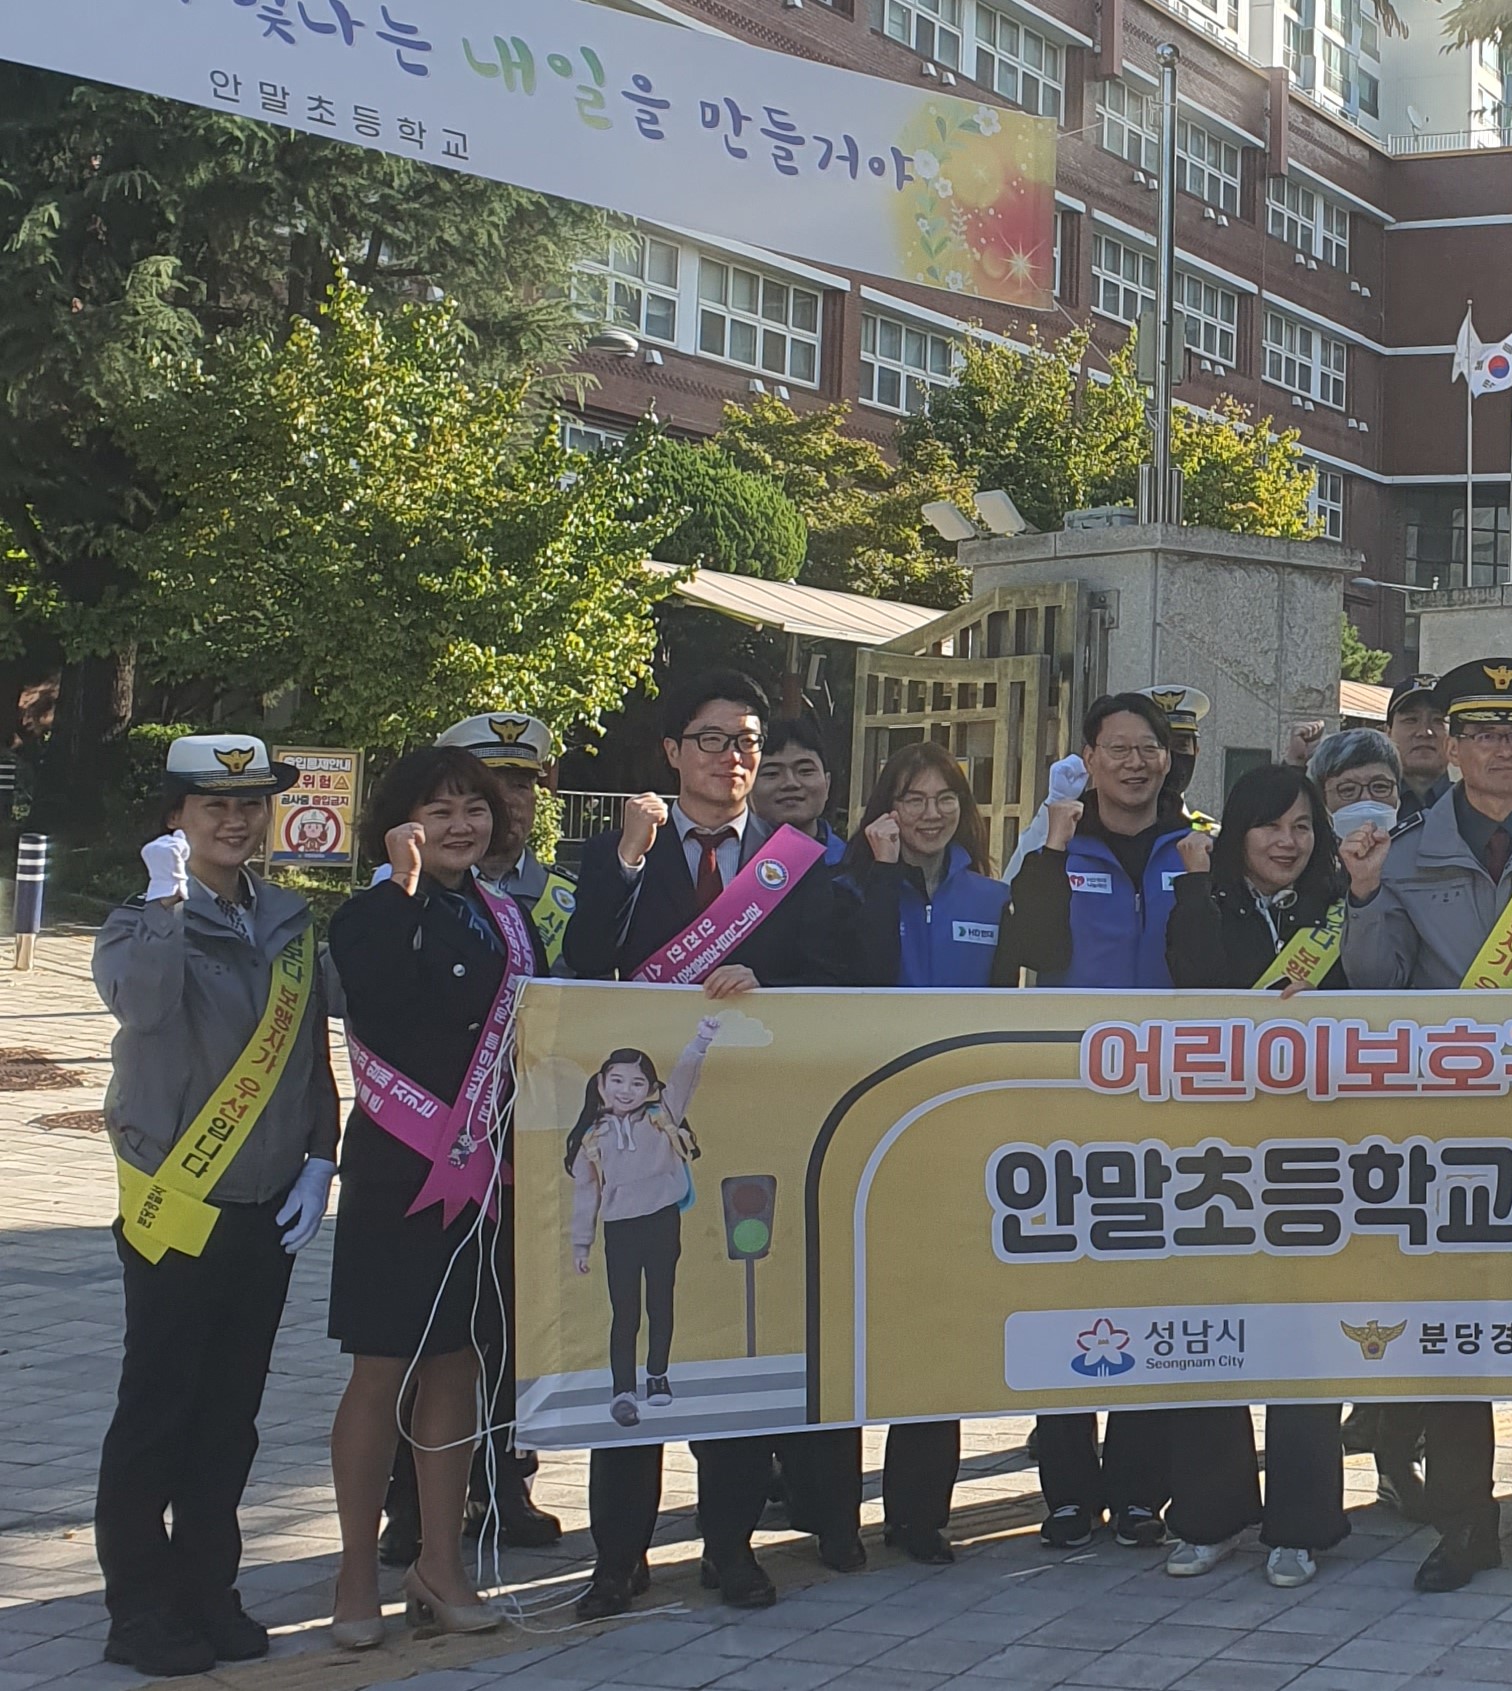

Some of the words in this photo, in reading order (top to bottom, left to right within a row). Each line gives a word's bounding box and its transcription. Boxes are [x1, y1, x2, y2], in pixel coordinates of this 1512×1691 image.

[209, 68, 472, 162] 안말초등학교
[462, 30, 670, 139] 내일을
[697, 97, 914, 191] 만들거야
[302, 774, 331, 788] 위험
[667, 918, 716, 964] 안전한
[251, 984, 299, 1074] 보행자가
[389, 1079, 439, 1120] 지키는
[180, 1076, 262, 1179] 우선입니다
[137, 1184, 167, 1230] 분당경찰서
[1145, 1318, 1246, 1356] 성남시
[1145, 1355, 1215, 1372] Seongnam
[1218, 1355, 1245, 1372] City
